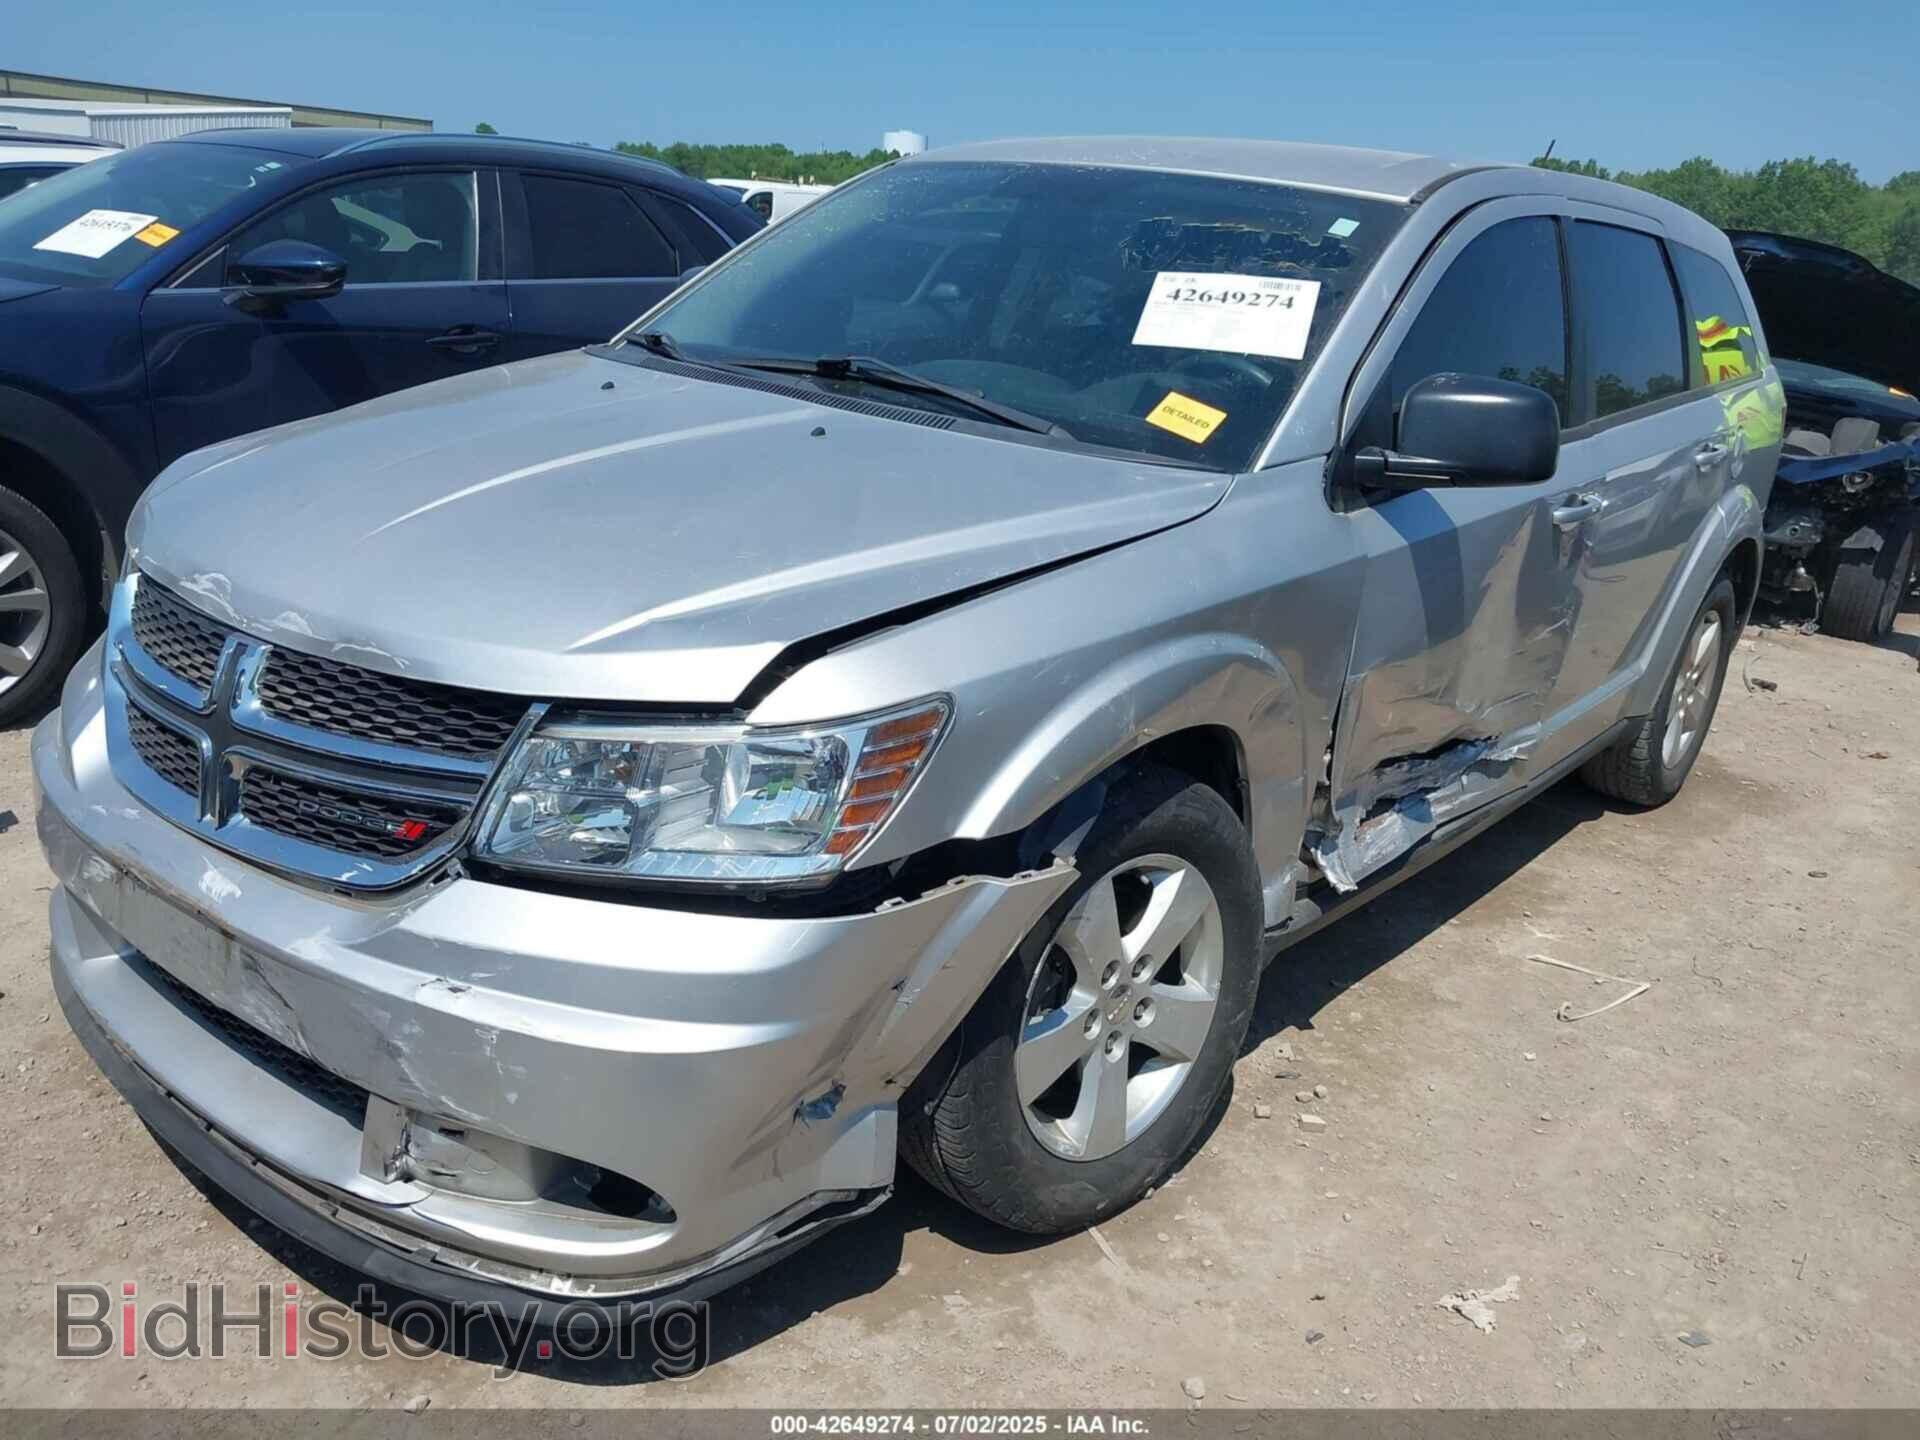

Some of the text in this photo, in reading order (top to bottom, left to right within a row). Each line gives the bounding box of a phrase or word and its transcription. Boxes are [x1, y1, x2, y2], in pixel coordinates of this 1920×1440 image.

[1166, 288, 1294, 309] 42649274
[1162, 405, 1210, 429] DETAILED
[299, 801, 407, 833] DODGE
